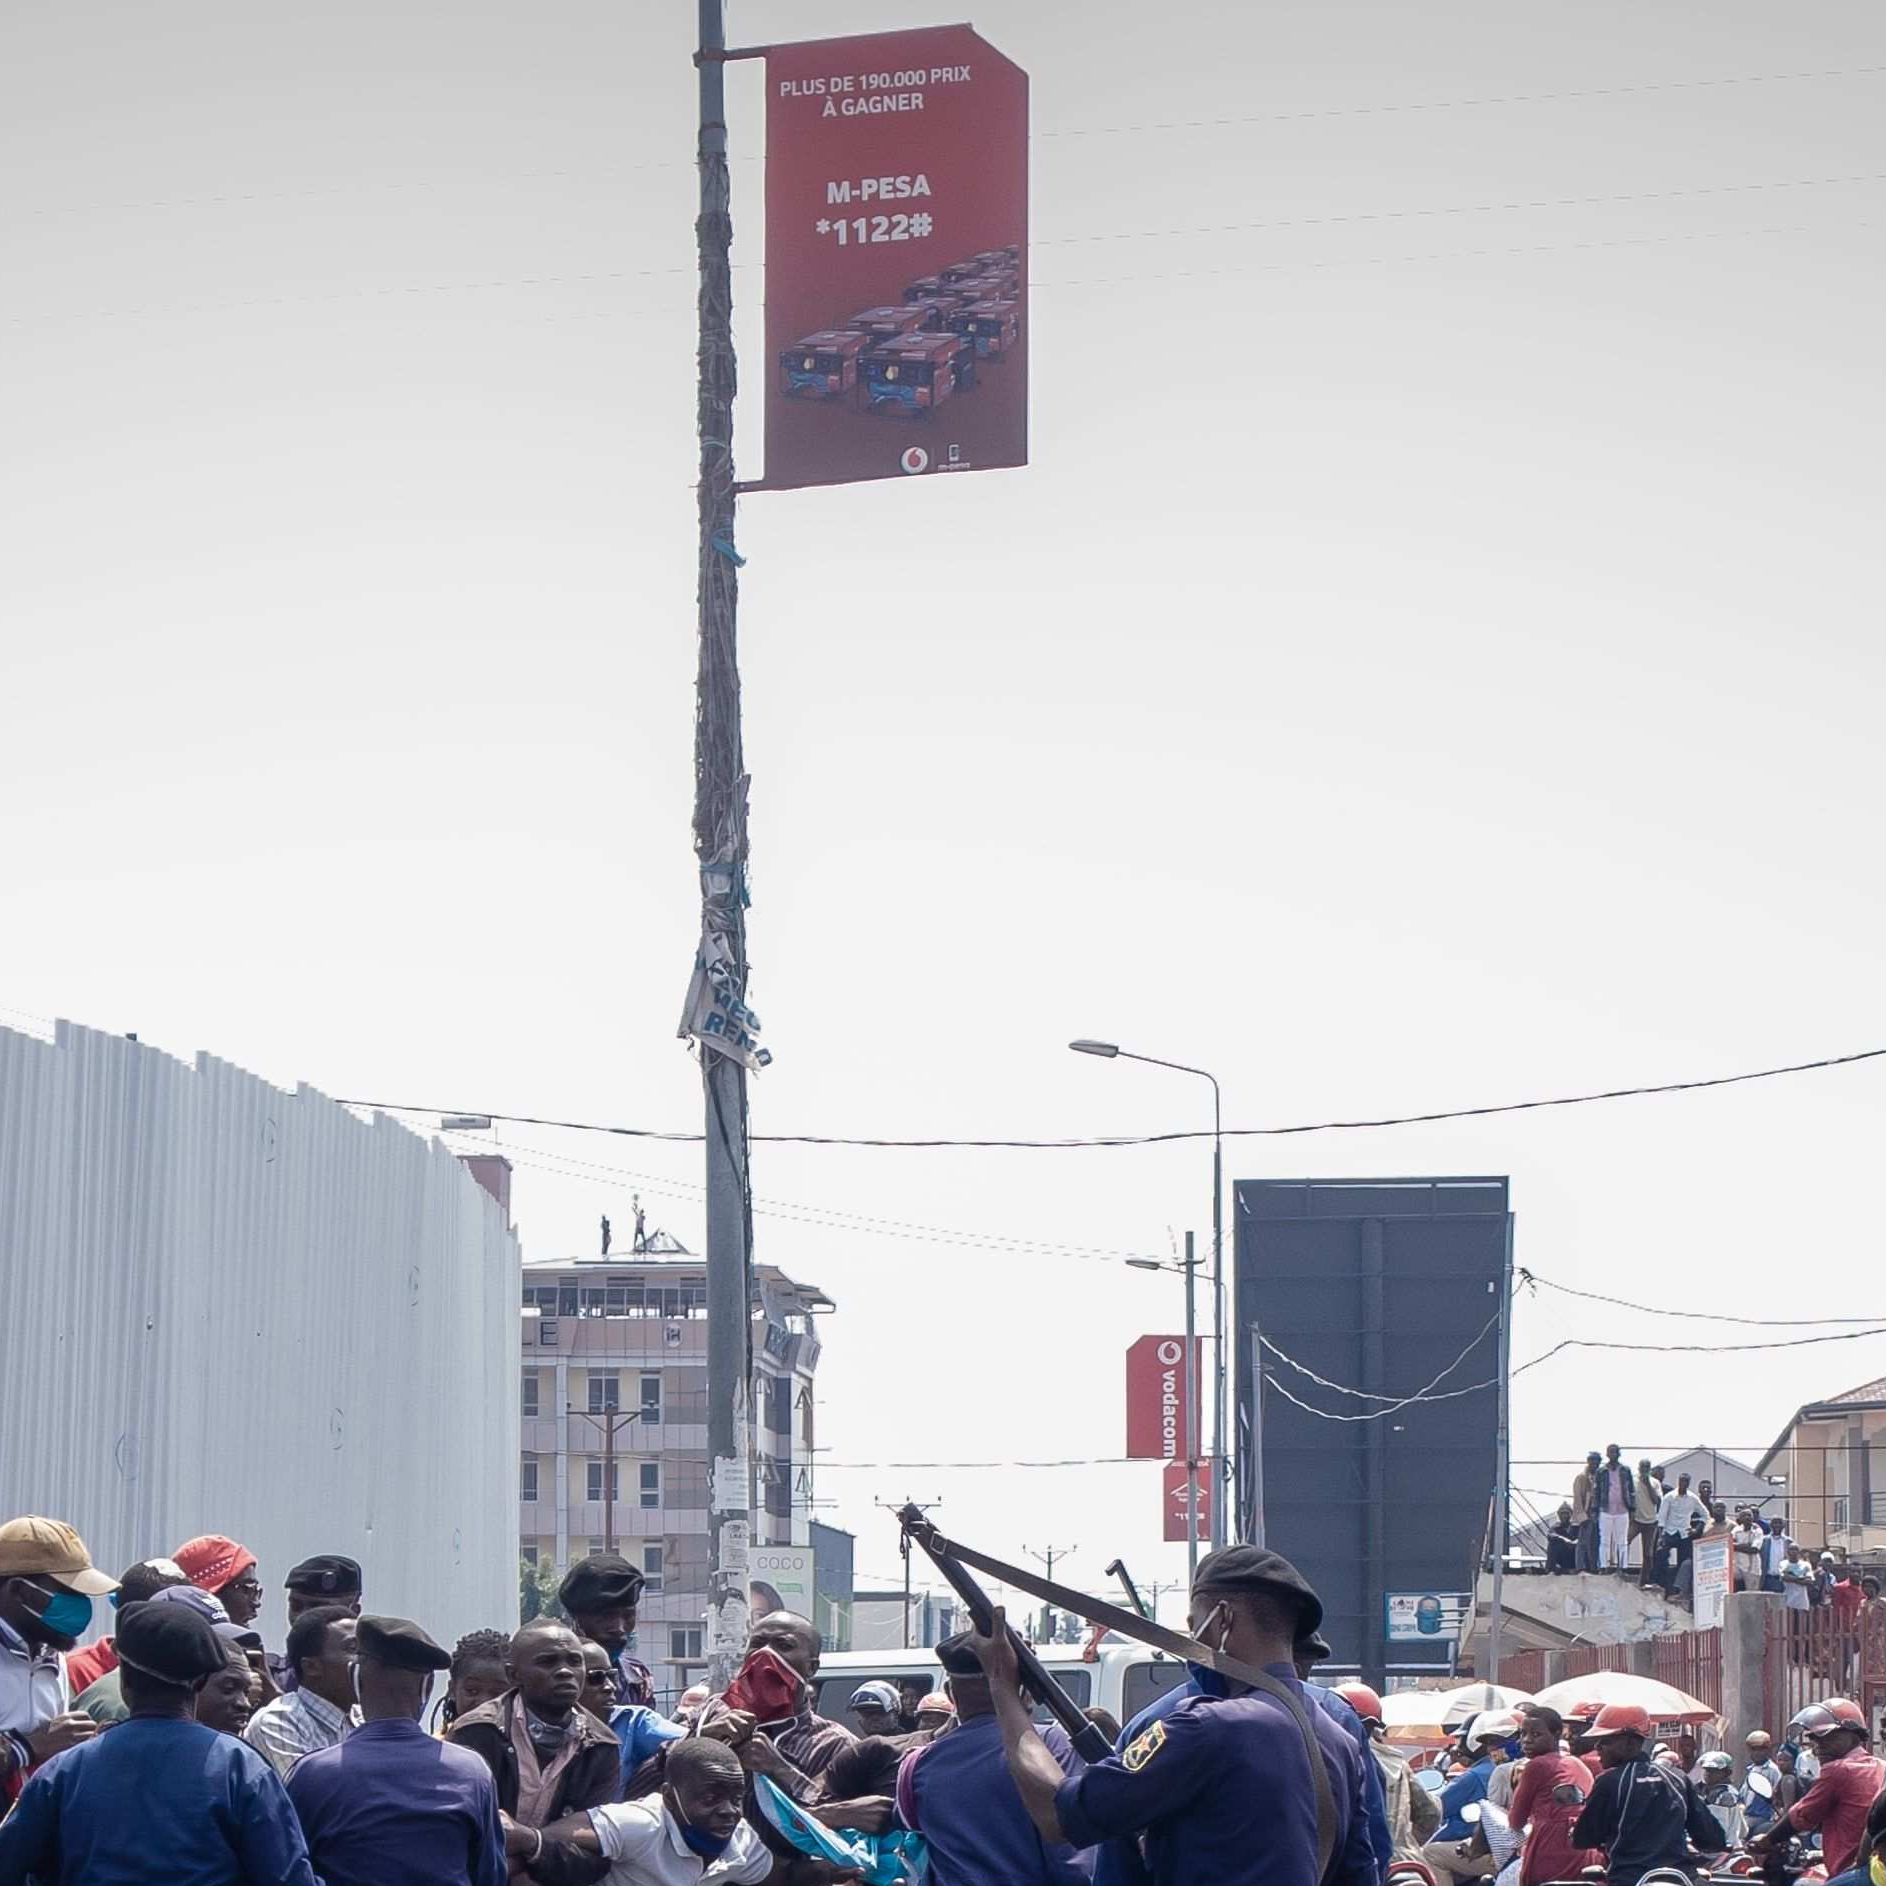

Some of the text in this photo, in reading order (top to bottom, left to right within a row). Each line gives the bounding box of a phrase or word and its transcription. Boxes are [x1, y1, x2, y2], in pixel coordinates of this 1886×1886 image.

[780, 65, 971, 96] PLUS DE 190.000 PRIX
[822, 92, 924, 118] À GAGNER
[826, 174, 931, 204] M-PESA
[1161, 1369, 1179, 1458] vodacom
[756, 1556, 805, 1570] COCO
